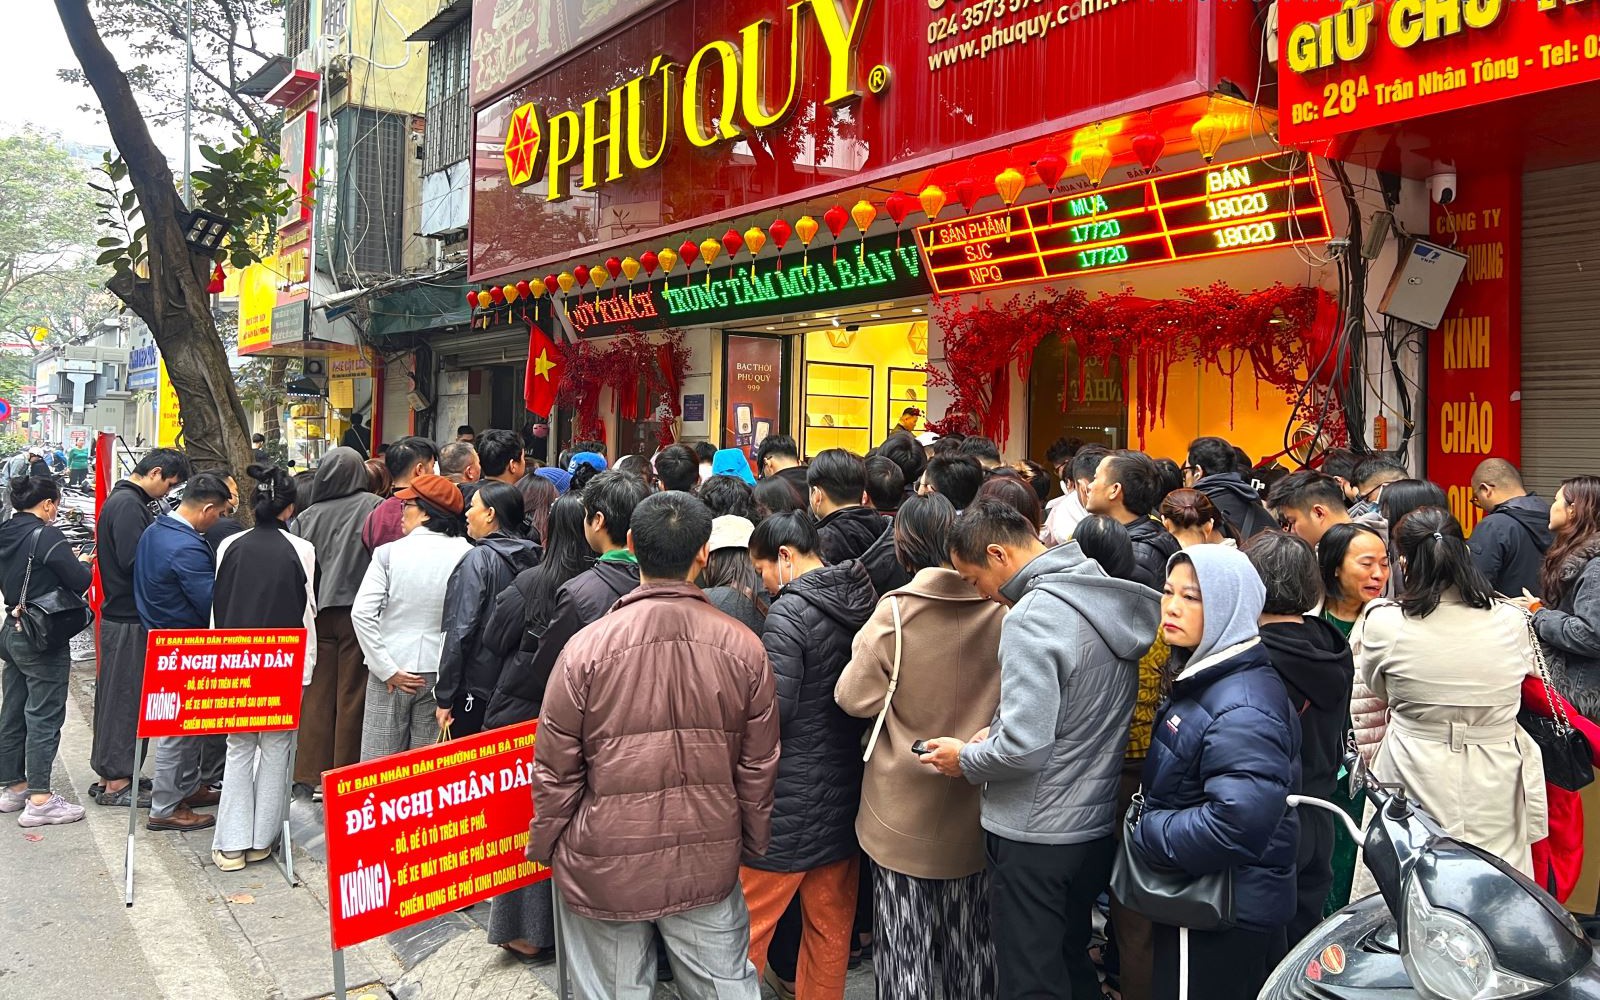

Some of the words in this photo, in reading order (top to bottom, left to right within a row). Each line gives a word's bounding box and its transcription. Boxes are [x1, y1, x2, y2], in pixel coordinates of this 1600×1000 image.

[927, 14, 958, 44] 024
[961, 0, 1006, 30] 3573
[928, 0, 1127, 71] www.phuquy.com.
[1292, 103, 1319, 125] ĐC:
[1419, 65, 1467, 97] Nhân
[1472, 55, 1519, 85] Tông
[1540, 40, 1579, 69] Tel:
[546, 54, 673, 201] PHÚ
[1076, 180, 1092, 190] VÀ
[1209, 165, 1251, 192] BÁN
[1070, 195, 1109, 217] MUA
[1208, 192, 1268, 221] 18020
[1437, 211, 1476, 234] CÔNG
[1483, 208, 1501, 228] TY
[940, 224, 967, 244] SẢN
[1071, 219, 1121, 243] 17720
[1214, 221, 1277, 248] 18020
[965, 242, 993, 262] SJC
[1078, 245, 1129, 268] 17720
[1467, 242, 1504, 286] QUANG
[662, 279, 728, 314] TRUNG
[726, 267, 779, 305] TÂM
[781, 263, 838, 298] MUA
[835, 245, 896, 289] BÁN
[969, 266, 1004, 285] NPQ
[599, 290, 658, 324] KHÁCH
[1444, 308, 1491, 369] KÍNH
[1441, 393, 1493, 455] CHÀO
[167, 637, 182, 645] BAN
[185, 636, 204, 644] NHÂN
[207, 636, 221, 644] DÂN
[253, 636, 265, 644] HAI
[158, 648, 180, 671] ĐỀ
[181, 654, 218, 673] NGHỊ
[220, 650, 261, 669] NHÂN
[264, 649, 294, 668] DÂN
[146, 687, 177, 721] KHÔNG
[355, 774, 378, 790] BAN
[380, 766, 410, 784] NHÂN
[413, 760, 434, 775] DÂN
[437, 749, 477, 769] PHƯỜNG
[480, 744, 496, 757] HAI
[498, 739, 511, 753] BÀ
[346, 792, 376, 835] ĐỀ
[380, 788, 434, 826] NGHỊ
[438, 771, 495, 809] NHÂN
[440, 820, 459, 841] TRÊN
[460, 816, 469, 836] HÈ
[409, 865, 420, 883] XE
[421, 857, 437, 879] MÁY
[439, 852, 458, 873] TRÊN
[470, 839, 485, 863] PHỐ
[486, 840, 498, 858] SAI
[499, 836, 513, 855] QUY
[340, 859, 384, 920] KHÔNG
[400, 892, 425, 918] CHIẾM
[426, 888, 446, 911] DỤNG
[459, 874, 473, 898] PHỐ
[475, 873, 492, 893] KINH
[493, 865, 517, 887] DOANH
